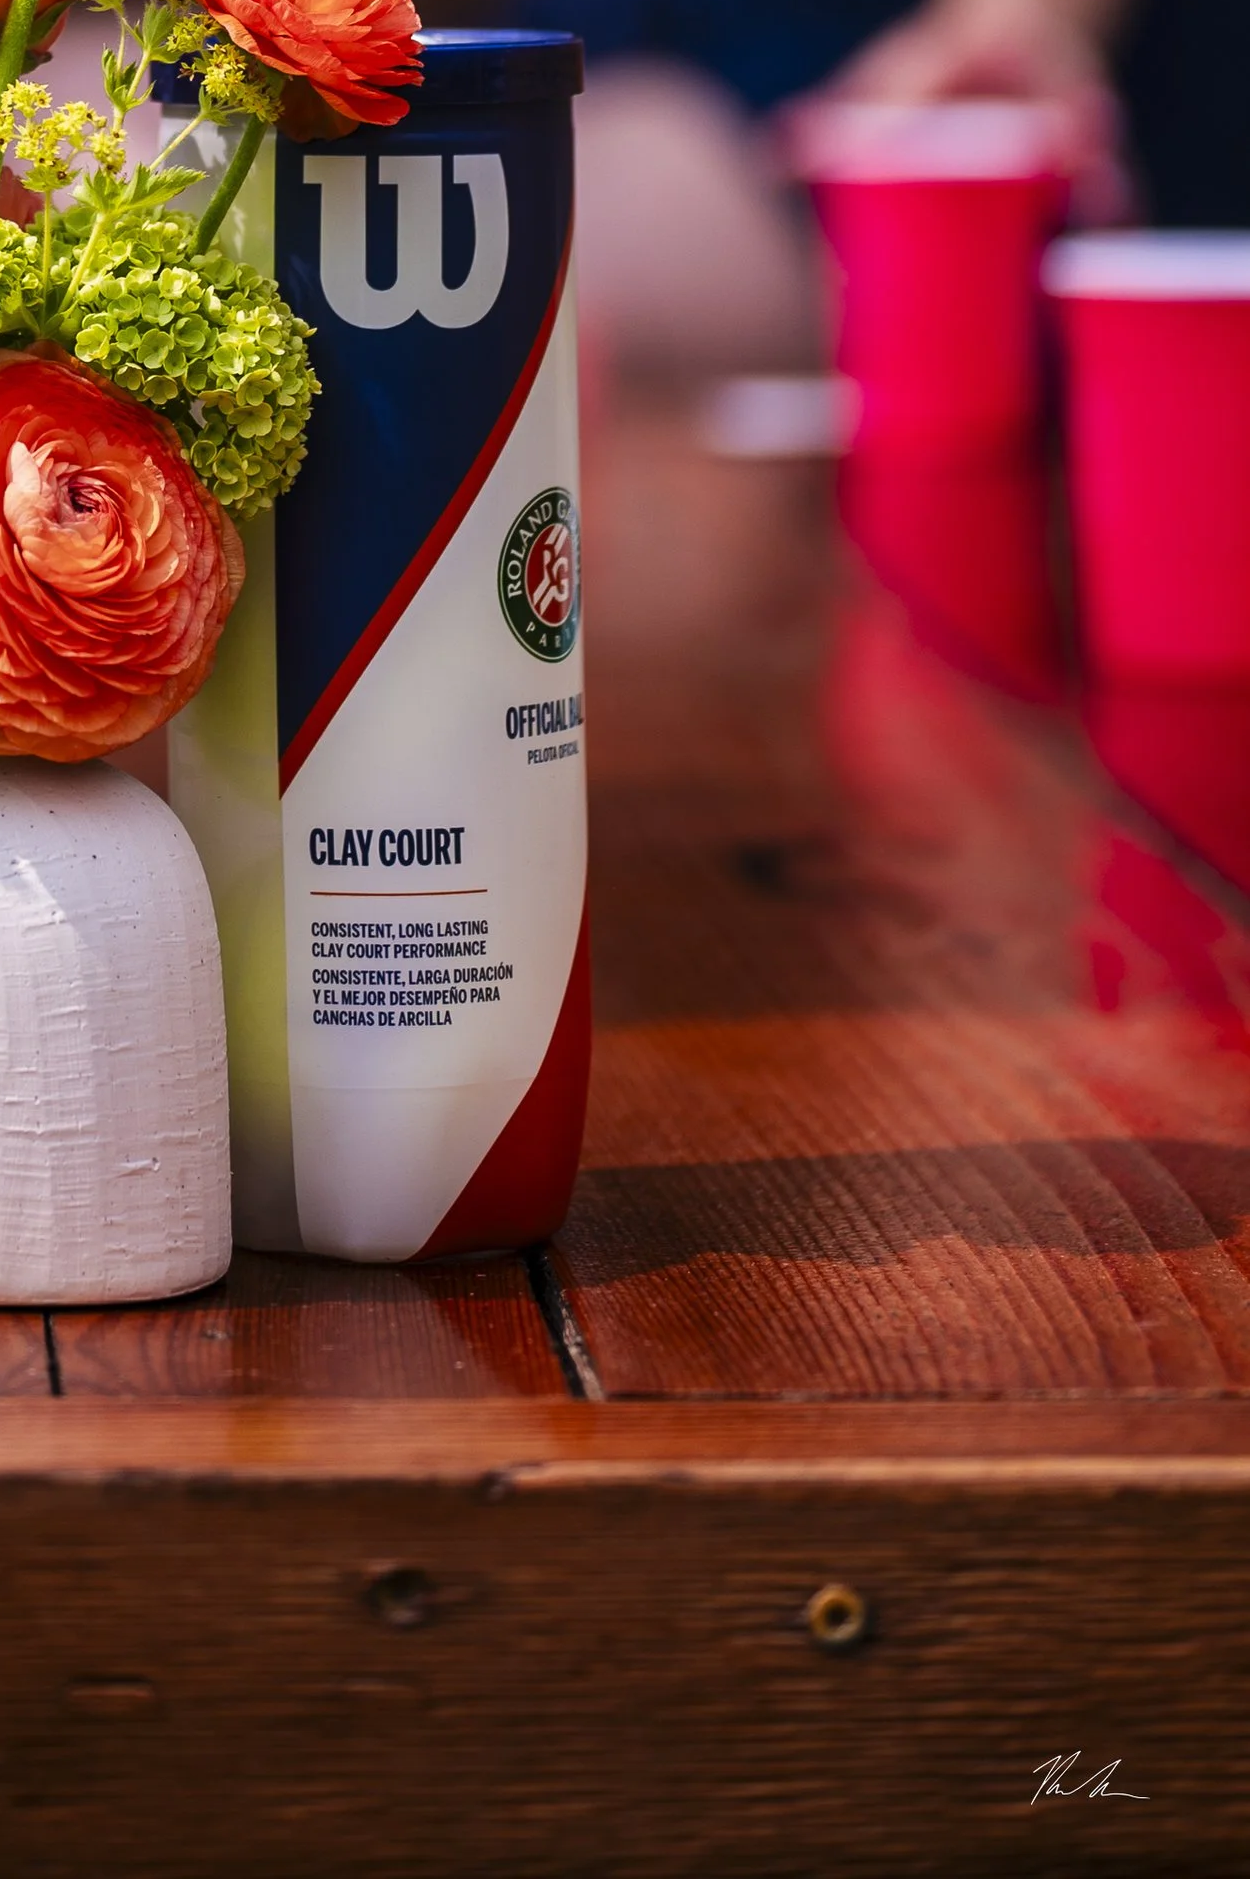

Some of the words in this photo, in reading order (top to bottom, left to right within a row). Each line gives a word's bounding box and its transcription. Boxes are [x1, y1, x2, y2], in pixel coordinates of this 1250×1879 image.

[507, 501, 553, 599] ROLAND
[505, 698, 568, 740] OFFICIAL
[527, 745, 557, 766] PELOTA
[309, 827, 373, 867] CLAY
[378, 826, 465, 867] COURT
[311, 921, 396, 941] CONSISTENT,
[399, 922, 434, 939] LONG
[437, 919, 489, 937] LASTING
[312, 942, 344, 958] CLAY
[347, 943, 391, 959] COURT
[393, 940, 487, 959] PERFORMANCE
[312, 968, 406, 988] CONSISTENTE,
[408, 968, 451, 986] LARGA
[453, 961, 514, 984] DURACIÓN
[313, 989, 322, 1005] Y
[324, 989, 339, 1005] EL
[341, 990, 386, 1006] MEJOR
[389, 986, 468, 1006] DESEMPEÑO
[470, 986, 501, 1003] PARA
[313, 1009, 375, 1027] CANCHAS
[378, 1011, 395, 1027] DE
[398, 1009, 453, 1027] ARCILLA
